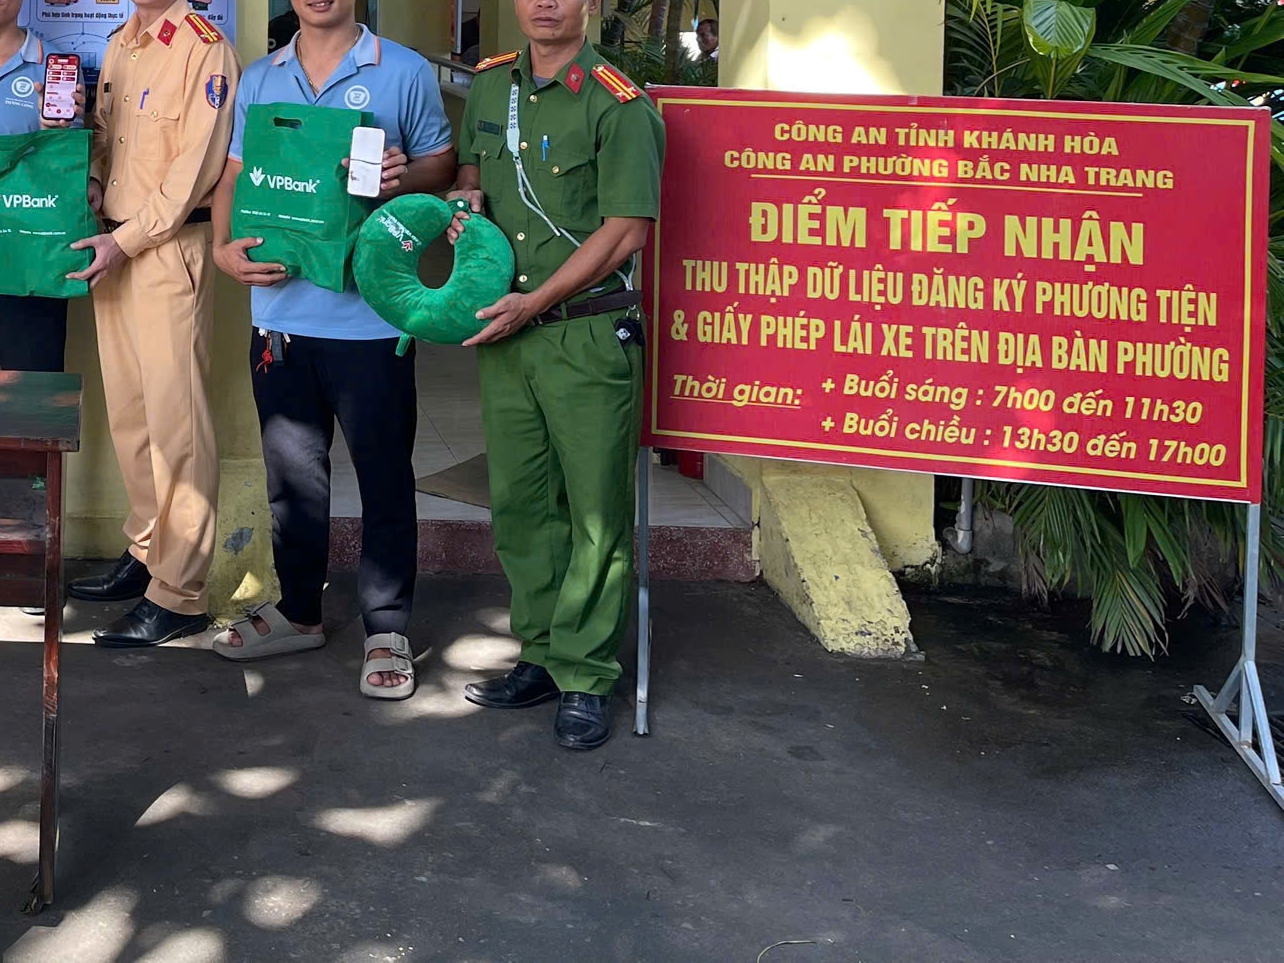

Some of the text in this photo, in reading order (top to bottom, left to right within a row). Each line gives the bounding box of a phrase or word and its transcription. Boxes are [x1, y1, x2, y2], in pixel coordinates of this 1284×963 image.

[774, 121, 1119, 156] CÔNG AN TỈNH KHÁNH HÒA
[267, 175, 316, 193] VPBank
[724, 148, 1174, 189] CÔNG AN PHƯỜNG BẮC NHA TRANG
[2, 194, 57, 208] VPBank
[749, 187, 1144, 272] ĐIỂM TIẾP NHẬN
[682, 258, 1217, 333] THU THẬP DỮ LIỆU ĐĂNG KÝ PHƯƠNG TIỆN
[671, 302, 1229, 382] & GIẤY PHÉP LÁI XE TRÊN ĐỊA BÀN PHƯỜNG
[674, 375, 803, 407] Thời gian:
[822, 370, 1203, 425] + Buổi sáng : 7h00 đến 11h30
[821, 409, 1226, 467] + Buổi chiều : 13h30 đến 17h00
